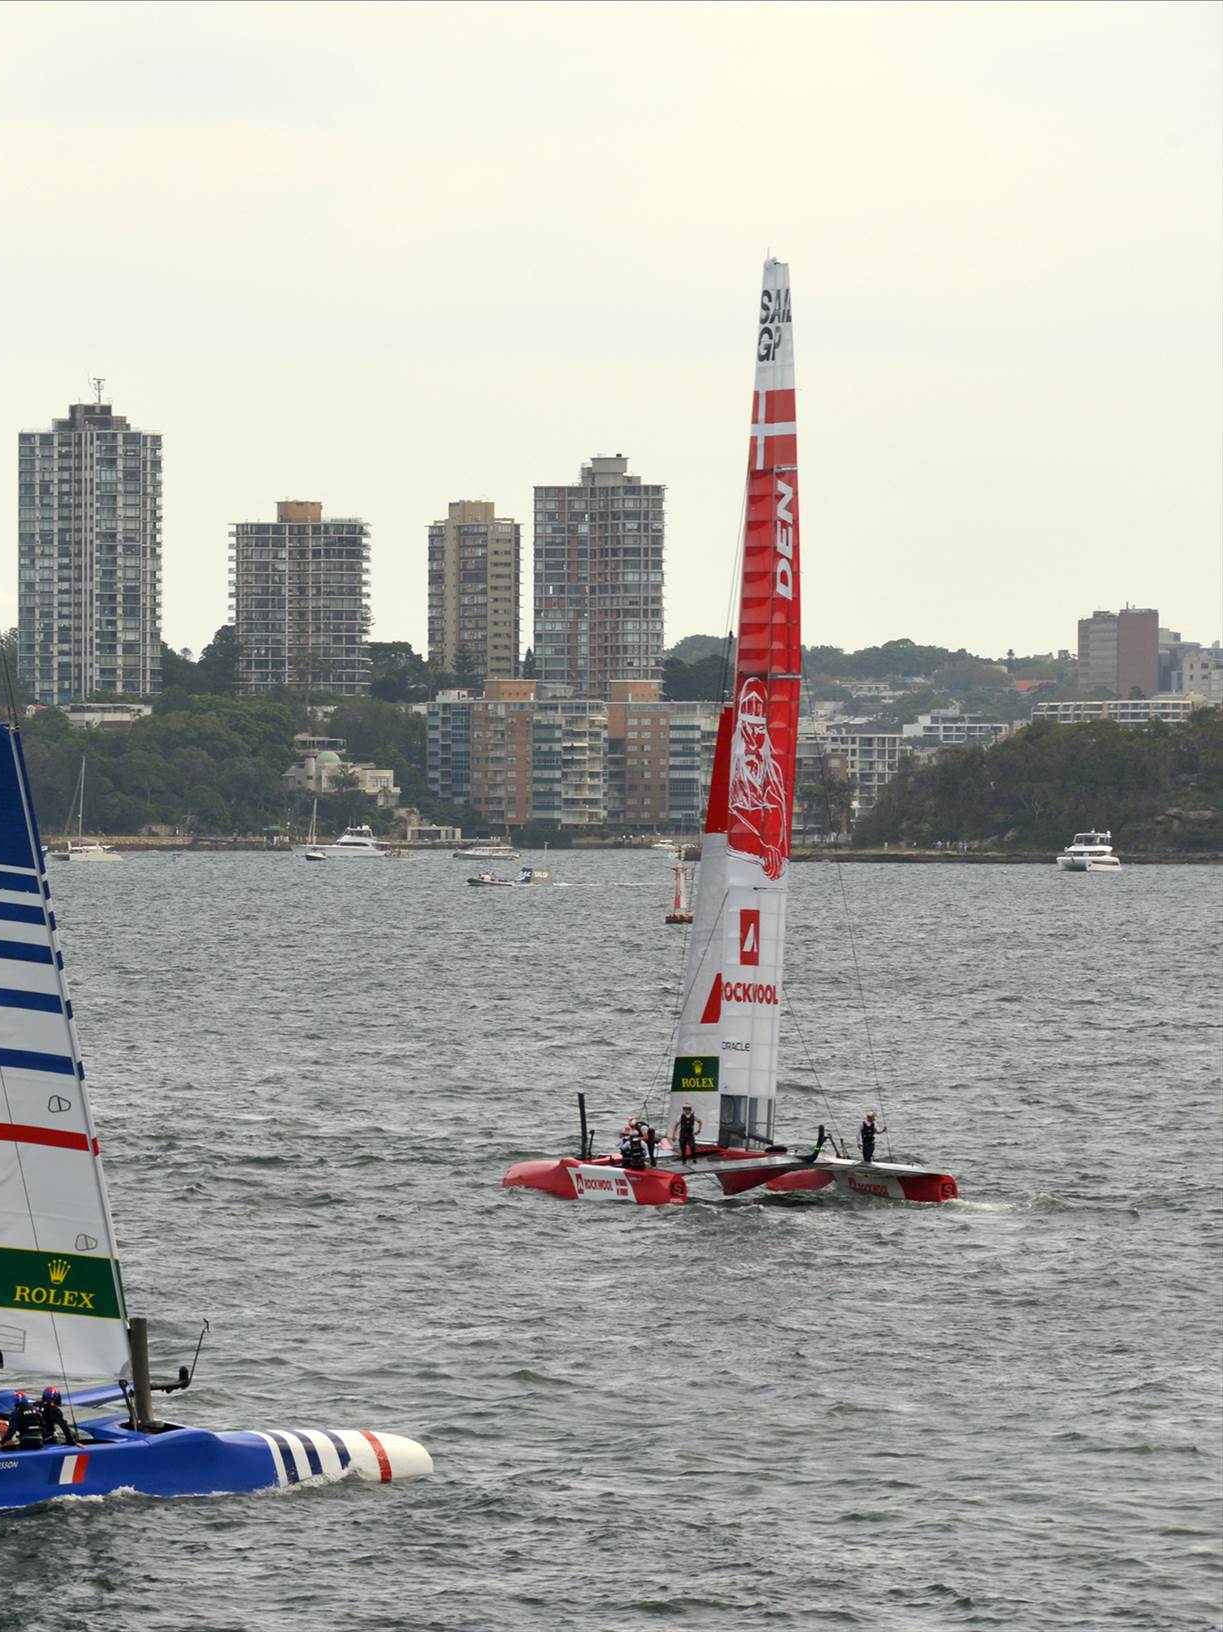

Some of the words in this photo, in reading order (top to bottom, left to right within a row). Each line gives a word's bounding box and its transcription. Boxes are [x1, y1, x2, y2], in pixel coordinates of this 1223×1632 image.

[759, 289, 792, 324] SAIL
[757, 326, 782, 362] GP
[777, 480, 794, 601] DEN
[721, 1041, 751, 1052] ORACLE
[681, 1077, 715, 1088] ROLEX
[14, 1285, 95, 1309] ROLEX
